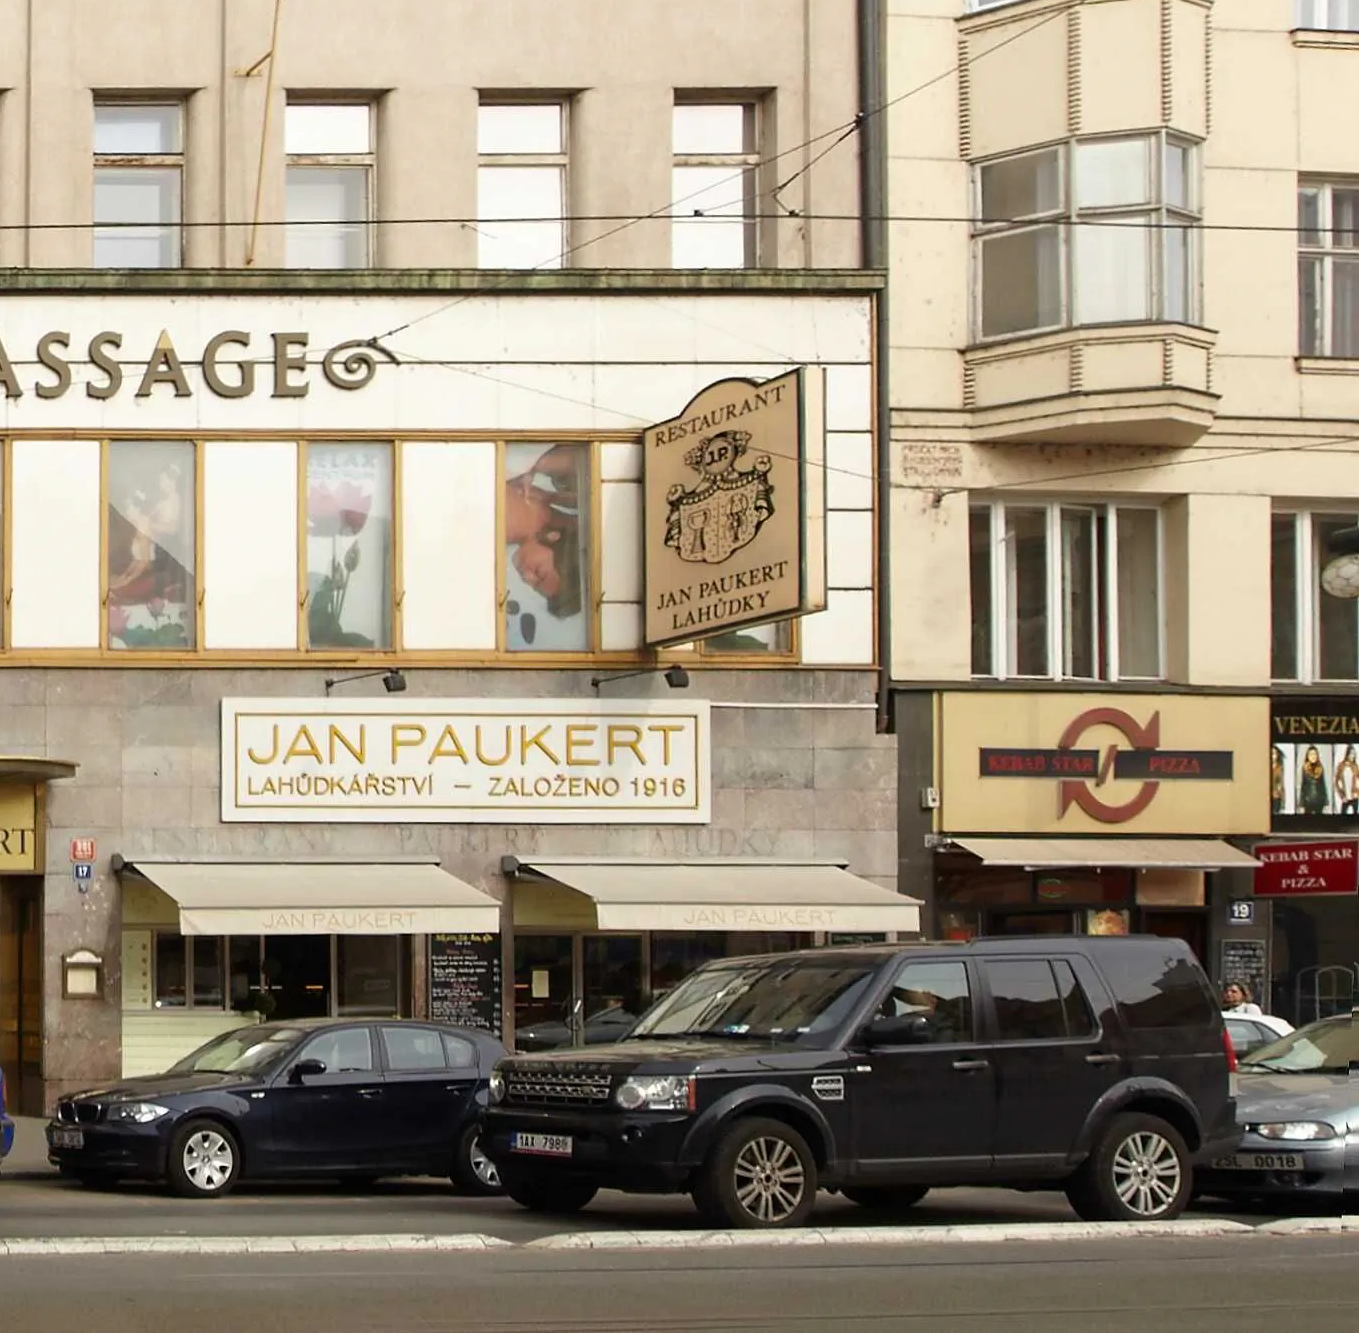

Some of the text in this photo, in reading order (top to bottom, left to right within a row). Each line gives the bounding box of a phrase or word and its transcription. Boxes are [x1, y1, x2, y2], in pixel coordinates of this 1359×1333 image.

[655, 385, 786, 447] RESTAURANT
[657, 561, 788, 610] JAN PAUKERT
[672, 591, 770, 630] LAHŮDKY
[247, 724, 685, 766] JAN PAUKERT
[988, 755, 1045, 771] KEBAB
[1149, 756, 1200, 773] PIZZA
[248, 772, 432, 796] LAHŮDKÁŘSTVÍ
[488, 773, 619, 797] ZALOŽENO
[631, 777, 686, 797] 1916
[1260, 848, 1353, 863] KEBAB STAR
[79, 866, 88, 877] 17
[1298, 864, 1310, 875] &
[1281, 876, 1327, 889] PIZZA
[684, 909, 836, 926] JAN PAUKERT
[1233, 904, 1249, 917] 19
[262, 911, 417, 930] JAN PAUKERT
